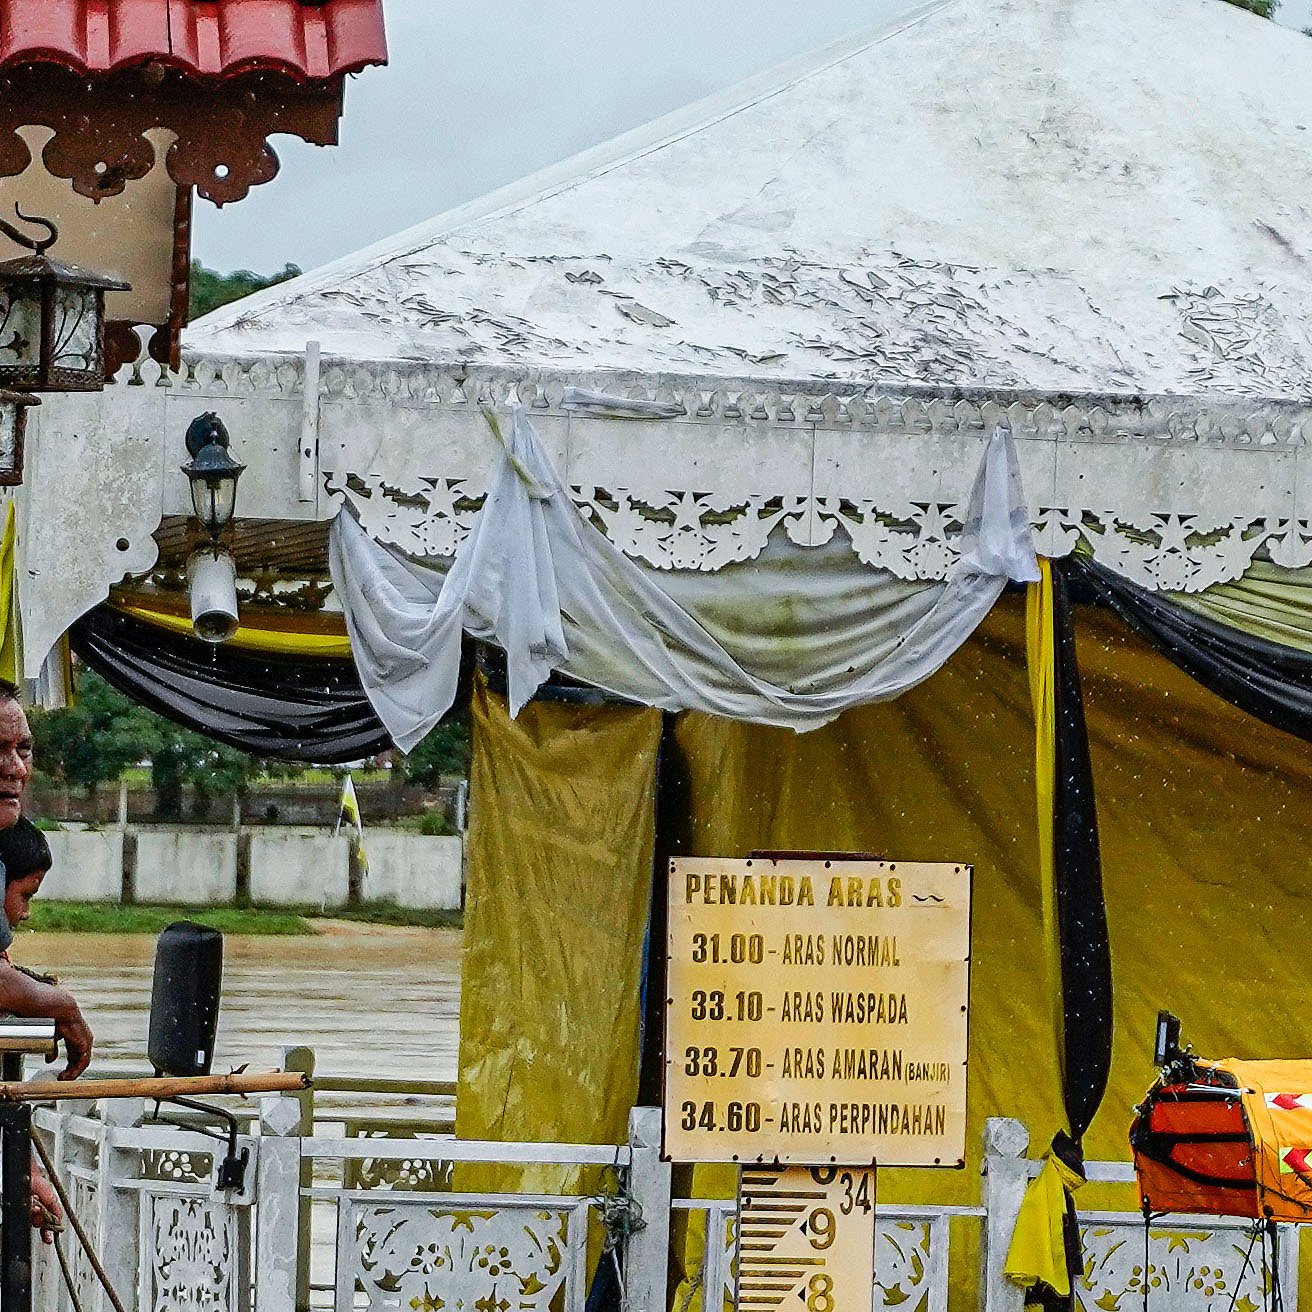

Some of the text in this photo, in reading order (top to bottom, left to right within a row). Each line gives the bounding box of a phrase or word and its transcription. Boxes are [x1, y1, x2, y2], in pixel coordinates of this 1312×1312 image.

[686, 873, 903, 908] PENANDA ARAS
[692, 932, 764, 964] 31.00
[782, 933, 825, 965] ARAS
[833, 935, 901, 967] NORMAL
[691, 990, 763, 1021] 33.10
[781, 991, 824, 1023] ARAS
[831, 992, 909, 1024] WASPADA
[685, 1047, 762, 1078] 33.70
[781, 1048, 825, 1080] ARAS
[831, 1049, 903, 1081] AMARAN
[681, 1101, 761, 1133] 34.60
[779, 1102, 822, 1134] ARAS
[830, 1103, 946, 1136] PERPINDAHAN
[840, 1172, 871, 1215] 34
[808, 1207, 836, 1250] 9
